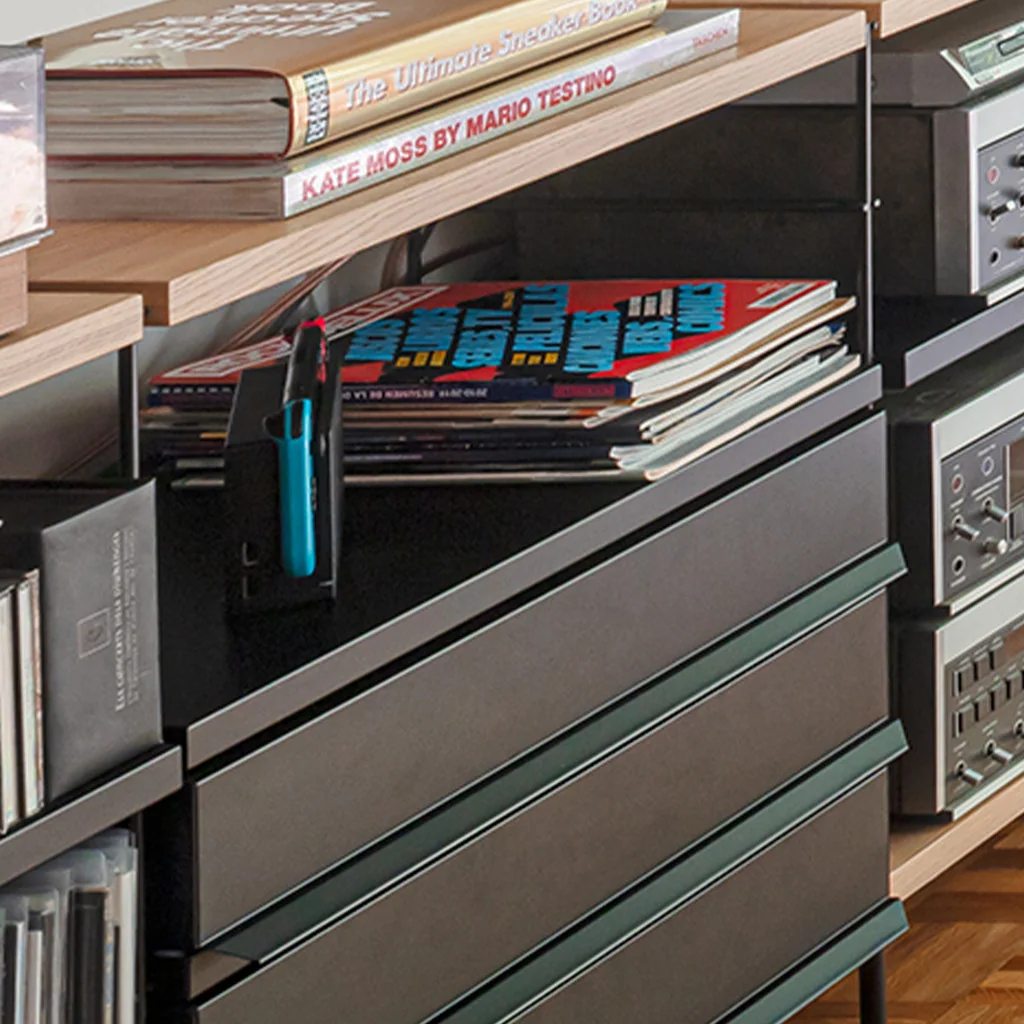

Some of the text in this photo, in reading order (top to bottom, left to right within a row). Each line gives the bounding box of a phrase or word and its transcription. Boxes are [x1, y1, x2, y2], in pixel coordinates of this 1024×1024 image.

[344, 78, 388, 110] The
[394, 42, 493, 92] Ultimate
[498, 10, 583, 57] Sneaker
[302, 64, 617, 201] KATE MOSS BY MARIO TESTINO
